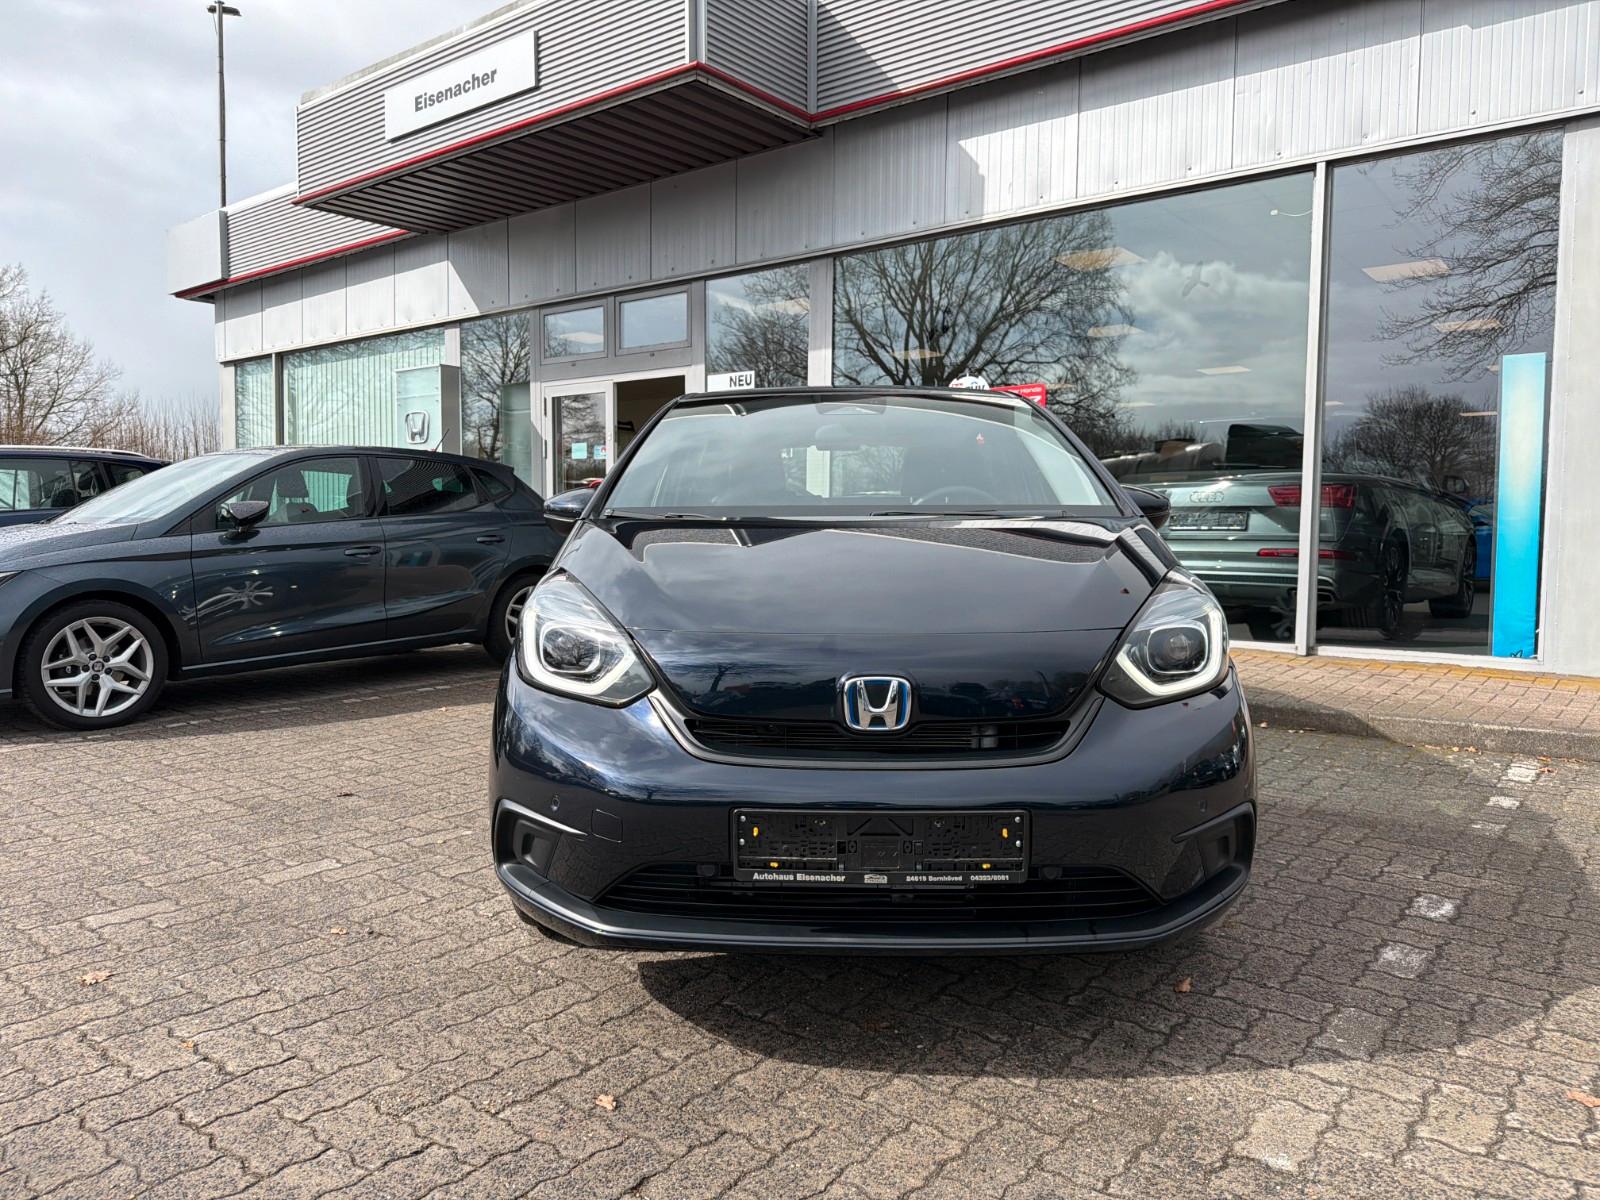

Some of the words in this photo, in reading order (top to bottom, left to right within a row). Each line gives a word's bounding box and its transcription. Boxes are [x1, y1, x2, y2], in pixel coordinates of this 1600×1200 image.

[414, 69, 498, 113] Eisenacher
[729, 373, 753, 388] NEU
[752, 872, 795, 881] Autohaus
[796, 873, 846, 882] Eisenacher
